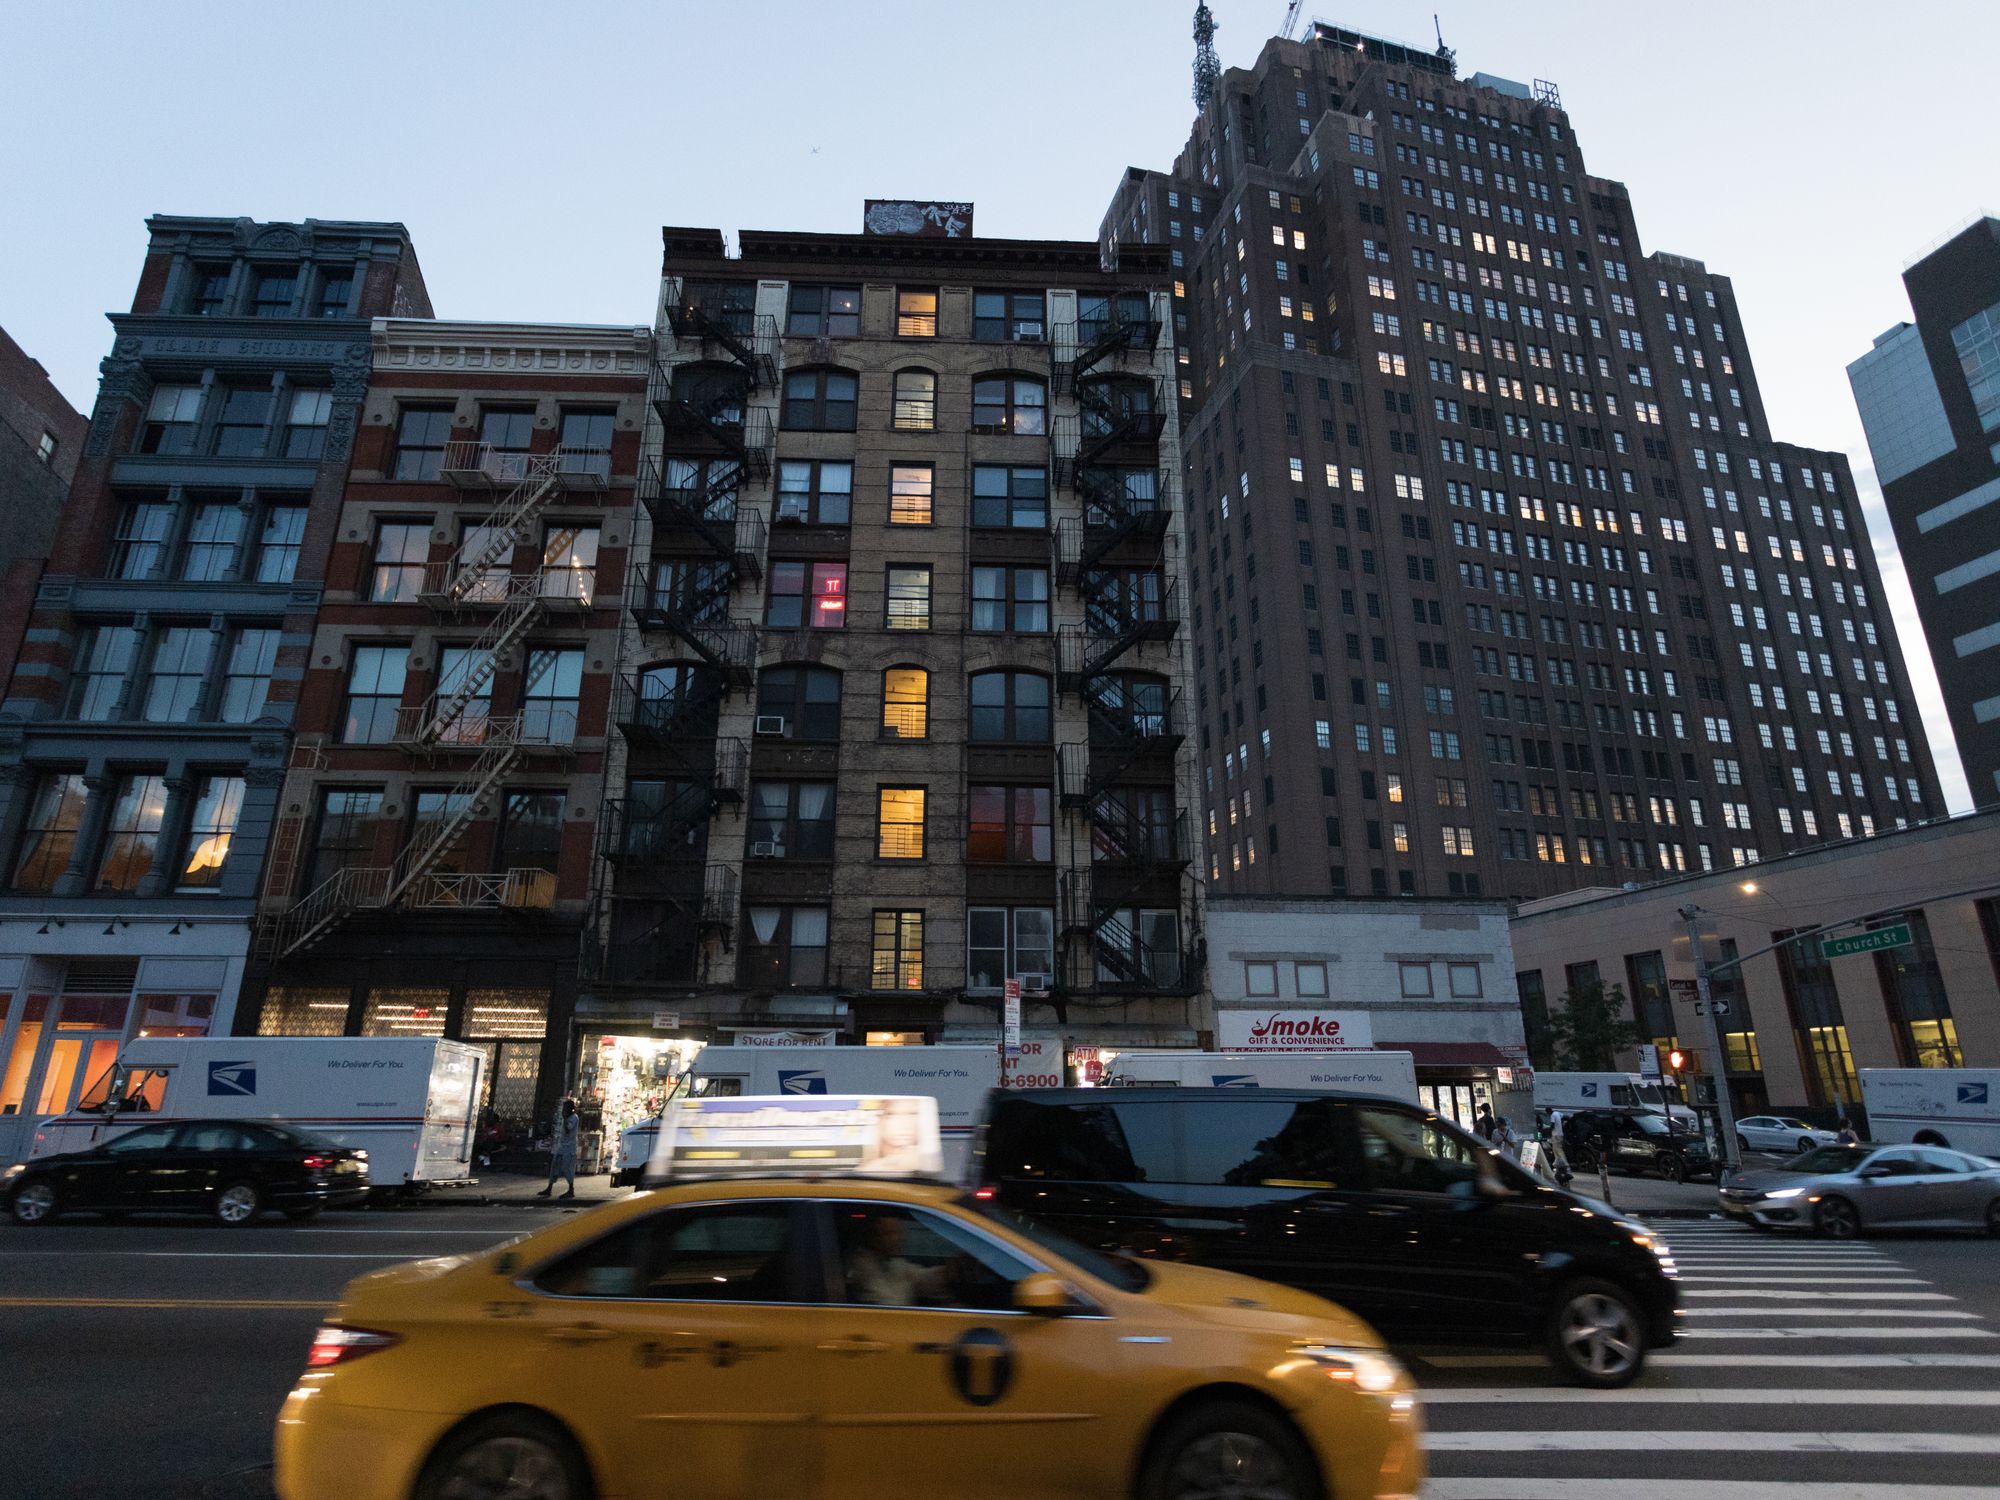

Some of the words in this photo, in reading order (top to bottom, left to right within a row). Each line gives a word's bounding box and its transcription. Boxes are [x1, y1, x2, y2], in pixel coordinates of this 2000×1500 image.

[238, 341, 336, 356] BUILDING
[1835, 935, 1881, 953] Church
[1882, 931, 1897, 944] St
[742, 1036, 775, 1046] STORE
[777, 1038, 799, 1046] FOR
[801, 1037, 828, 1046] RENT
[1248, 1037, 1269, 1045] GIFT
[1271, 1037, 1278, 1045] &
[1280, 1037, 1345, 1045] CONVENIENCE
[1077, 1048, 1097, 1061] ATM
[327, 1060, 341, 1068] We
[341, 1060, 371, 1068] Deliver
[372, 1060, 387, 1068] For
[894, 1069, 907, 1078] We
[908, 1069, 936, 1078] Deliver
[938, 1069, 951, 1078] For
[1310, 1074, 1322, 1082] We
[1324, 1074, 1351, 1082] Deliver
[999, 1074, 1058, 1088] 6-6900
